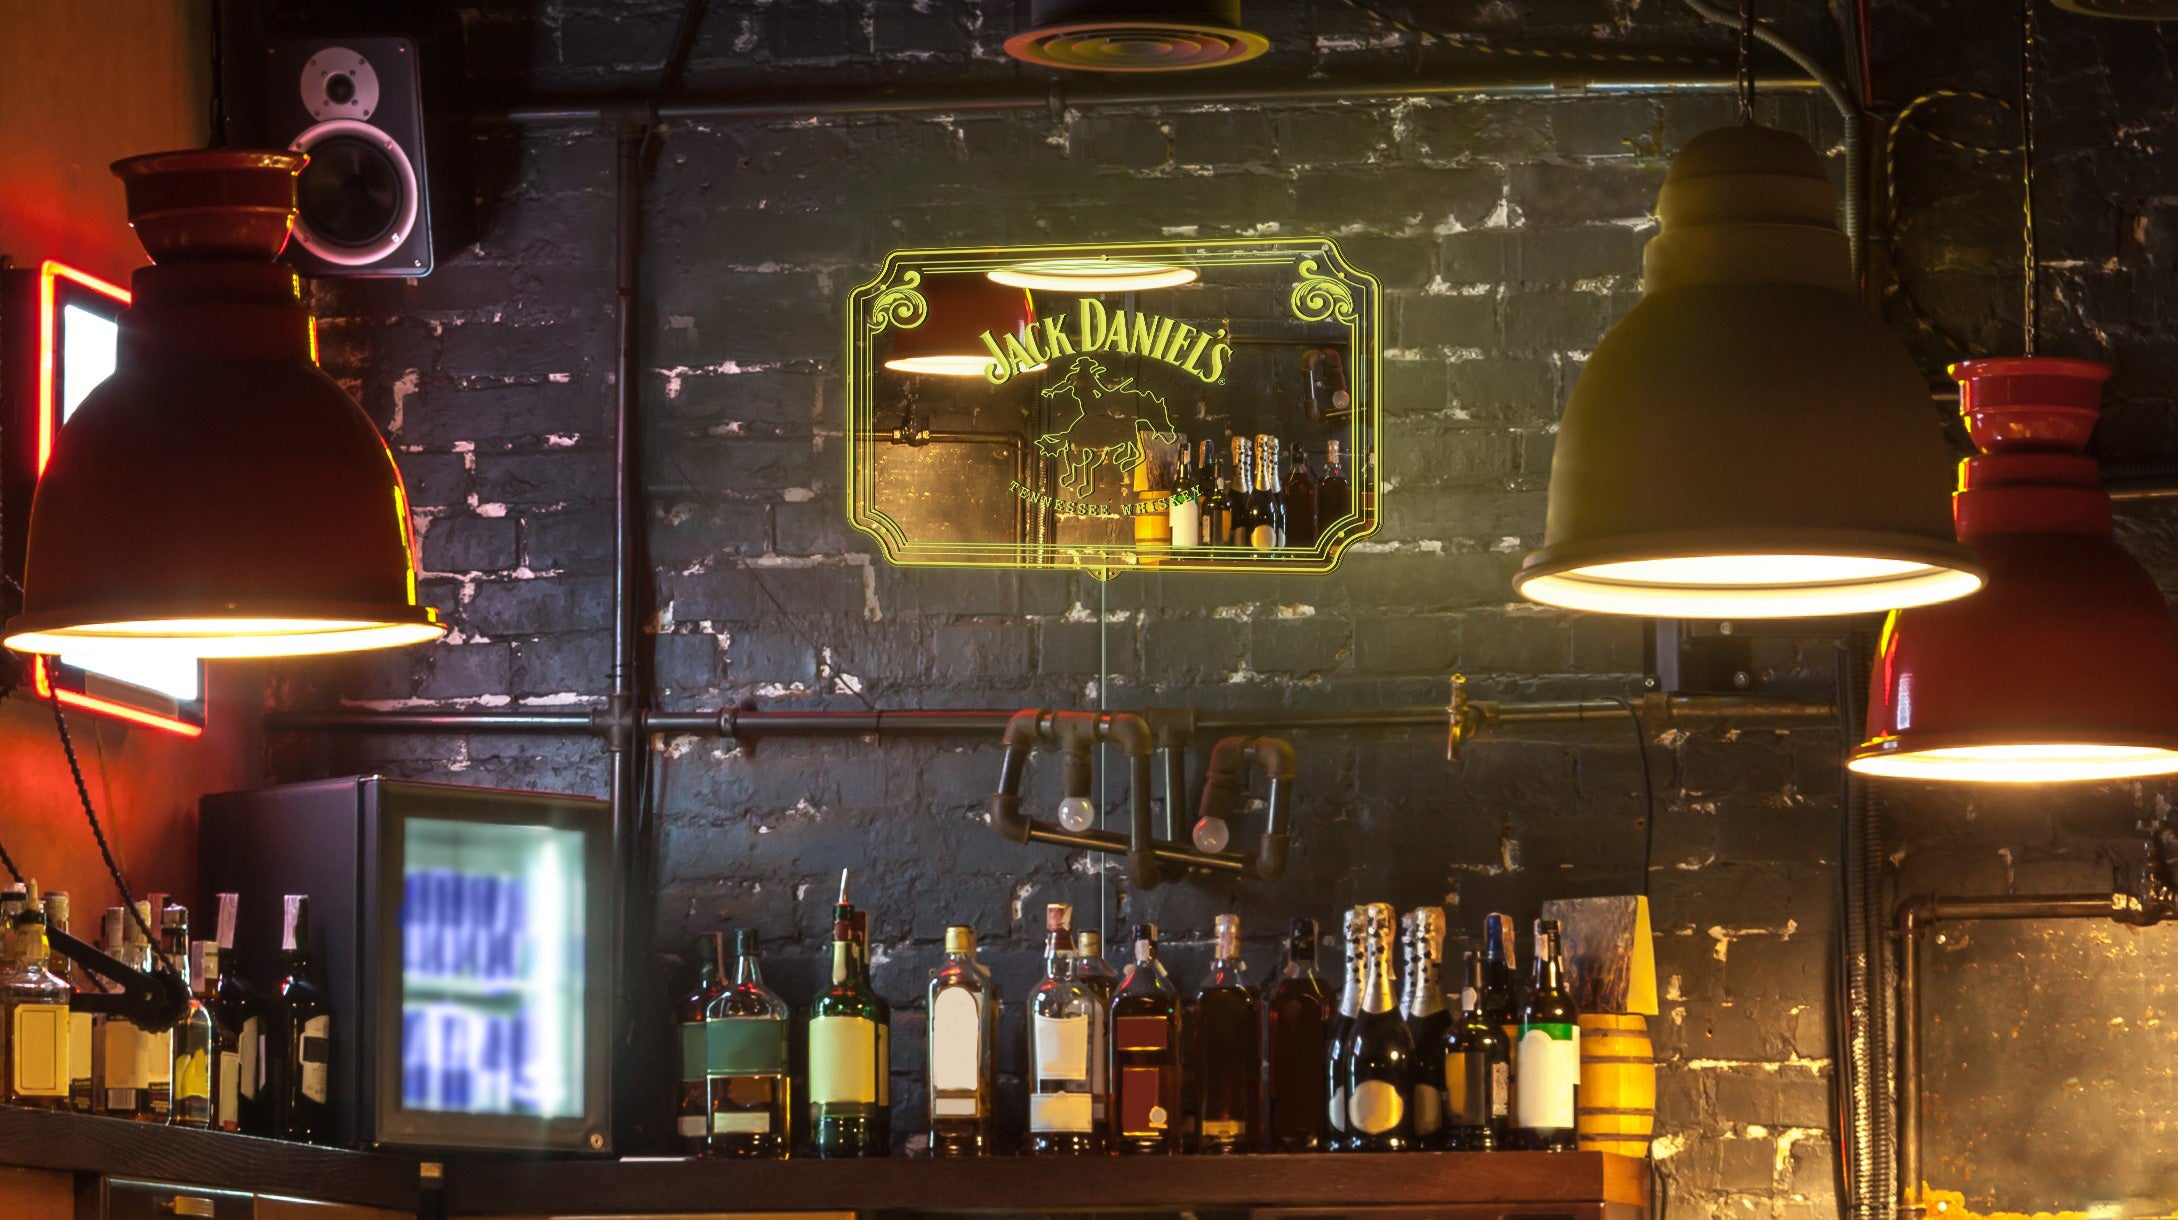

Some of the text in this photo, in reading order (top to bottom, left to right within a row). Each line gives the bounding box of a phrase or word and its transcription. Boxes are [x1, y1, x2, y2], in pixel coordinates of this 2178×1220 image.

[979, 298, 1234, 385] JACK DANIEL'S
[1008, 480, 1202, 516] TENNESSEE WHISKEY
